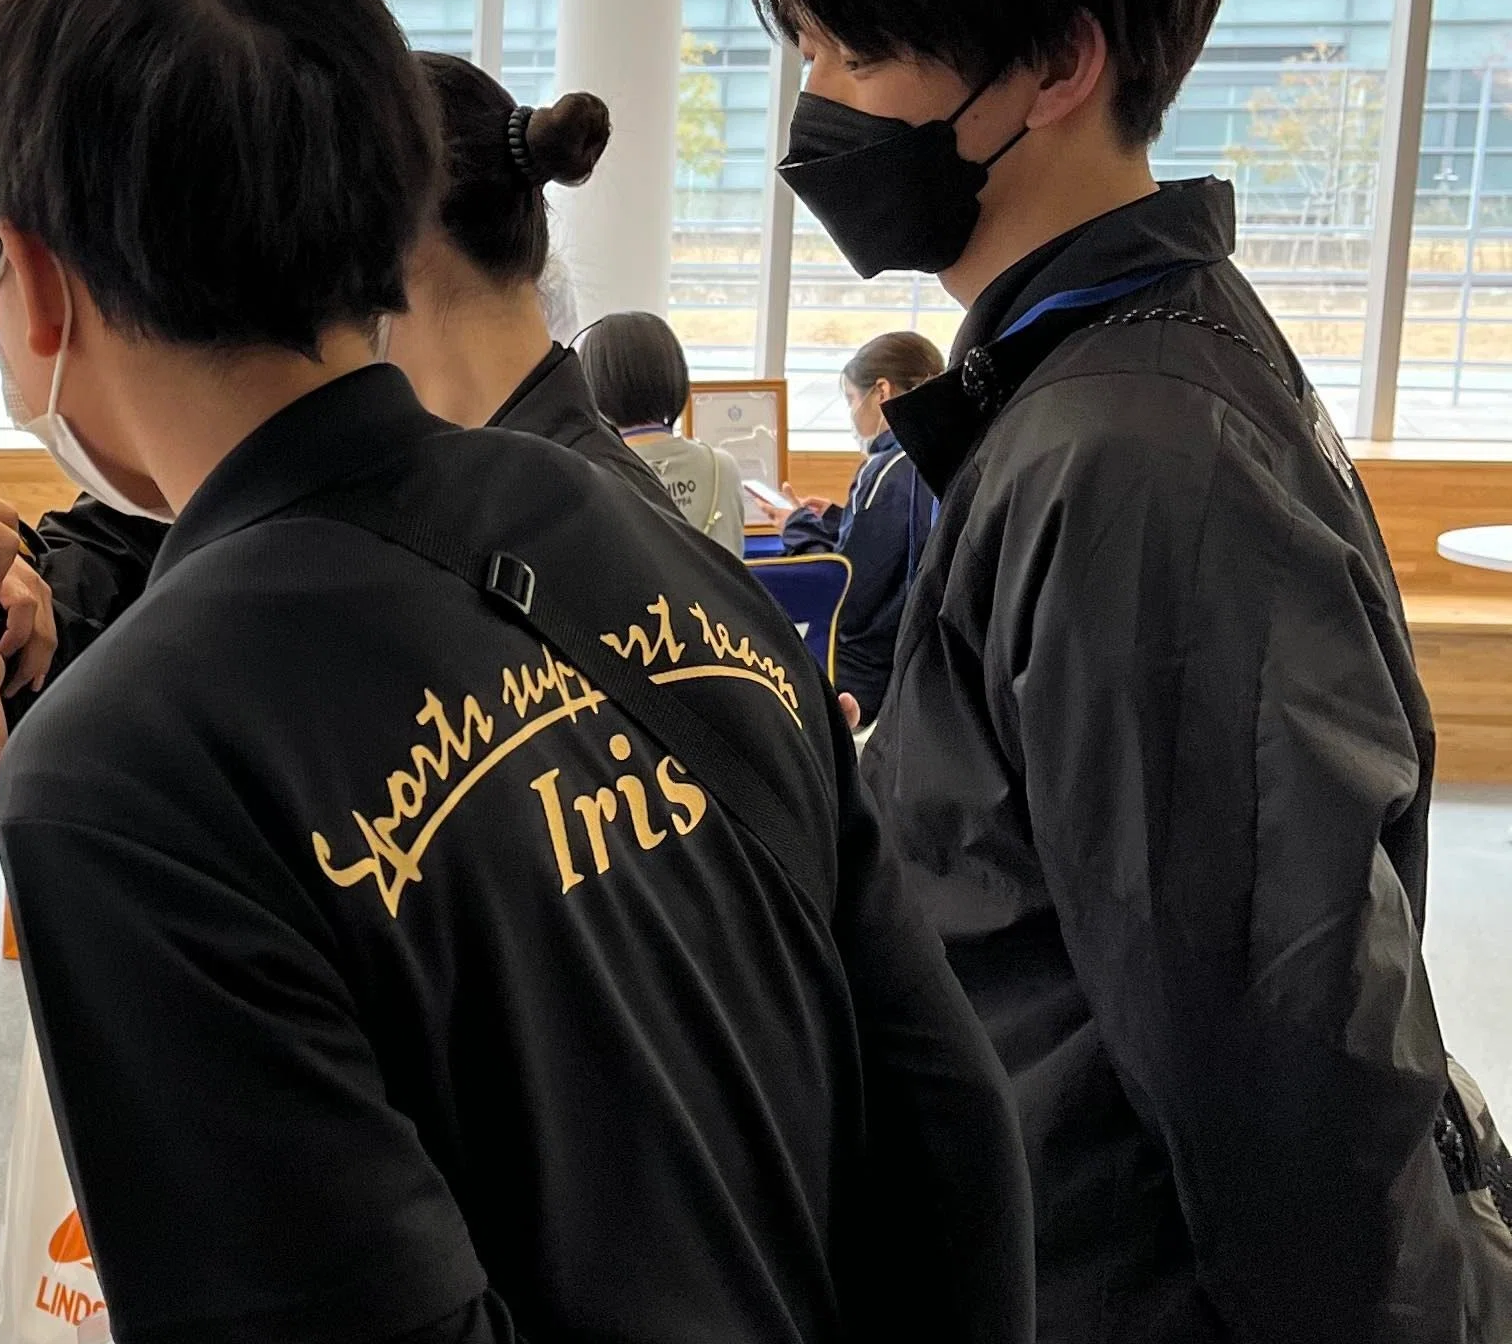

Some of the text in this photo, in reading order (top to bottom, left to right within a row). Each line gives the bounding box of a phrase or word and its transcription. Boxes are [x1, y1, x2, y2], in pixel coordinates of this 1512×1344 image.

[311, 687, 493, 918] Sports
[688, 601, 799, 711] team
[530, 734, 708, 895] Iris
